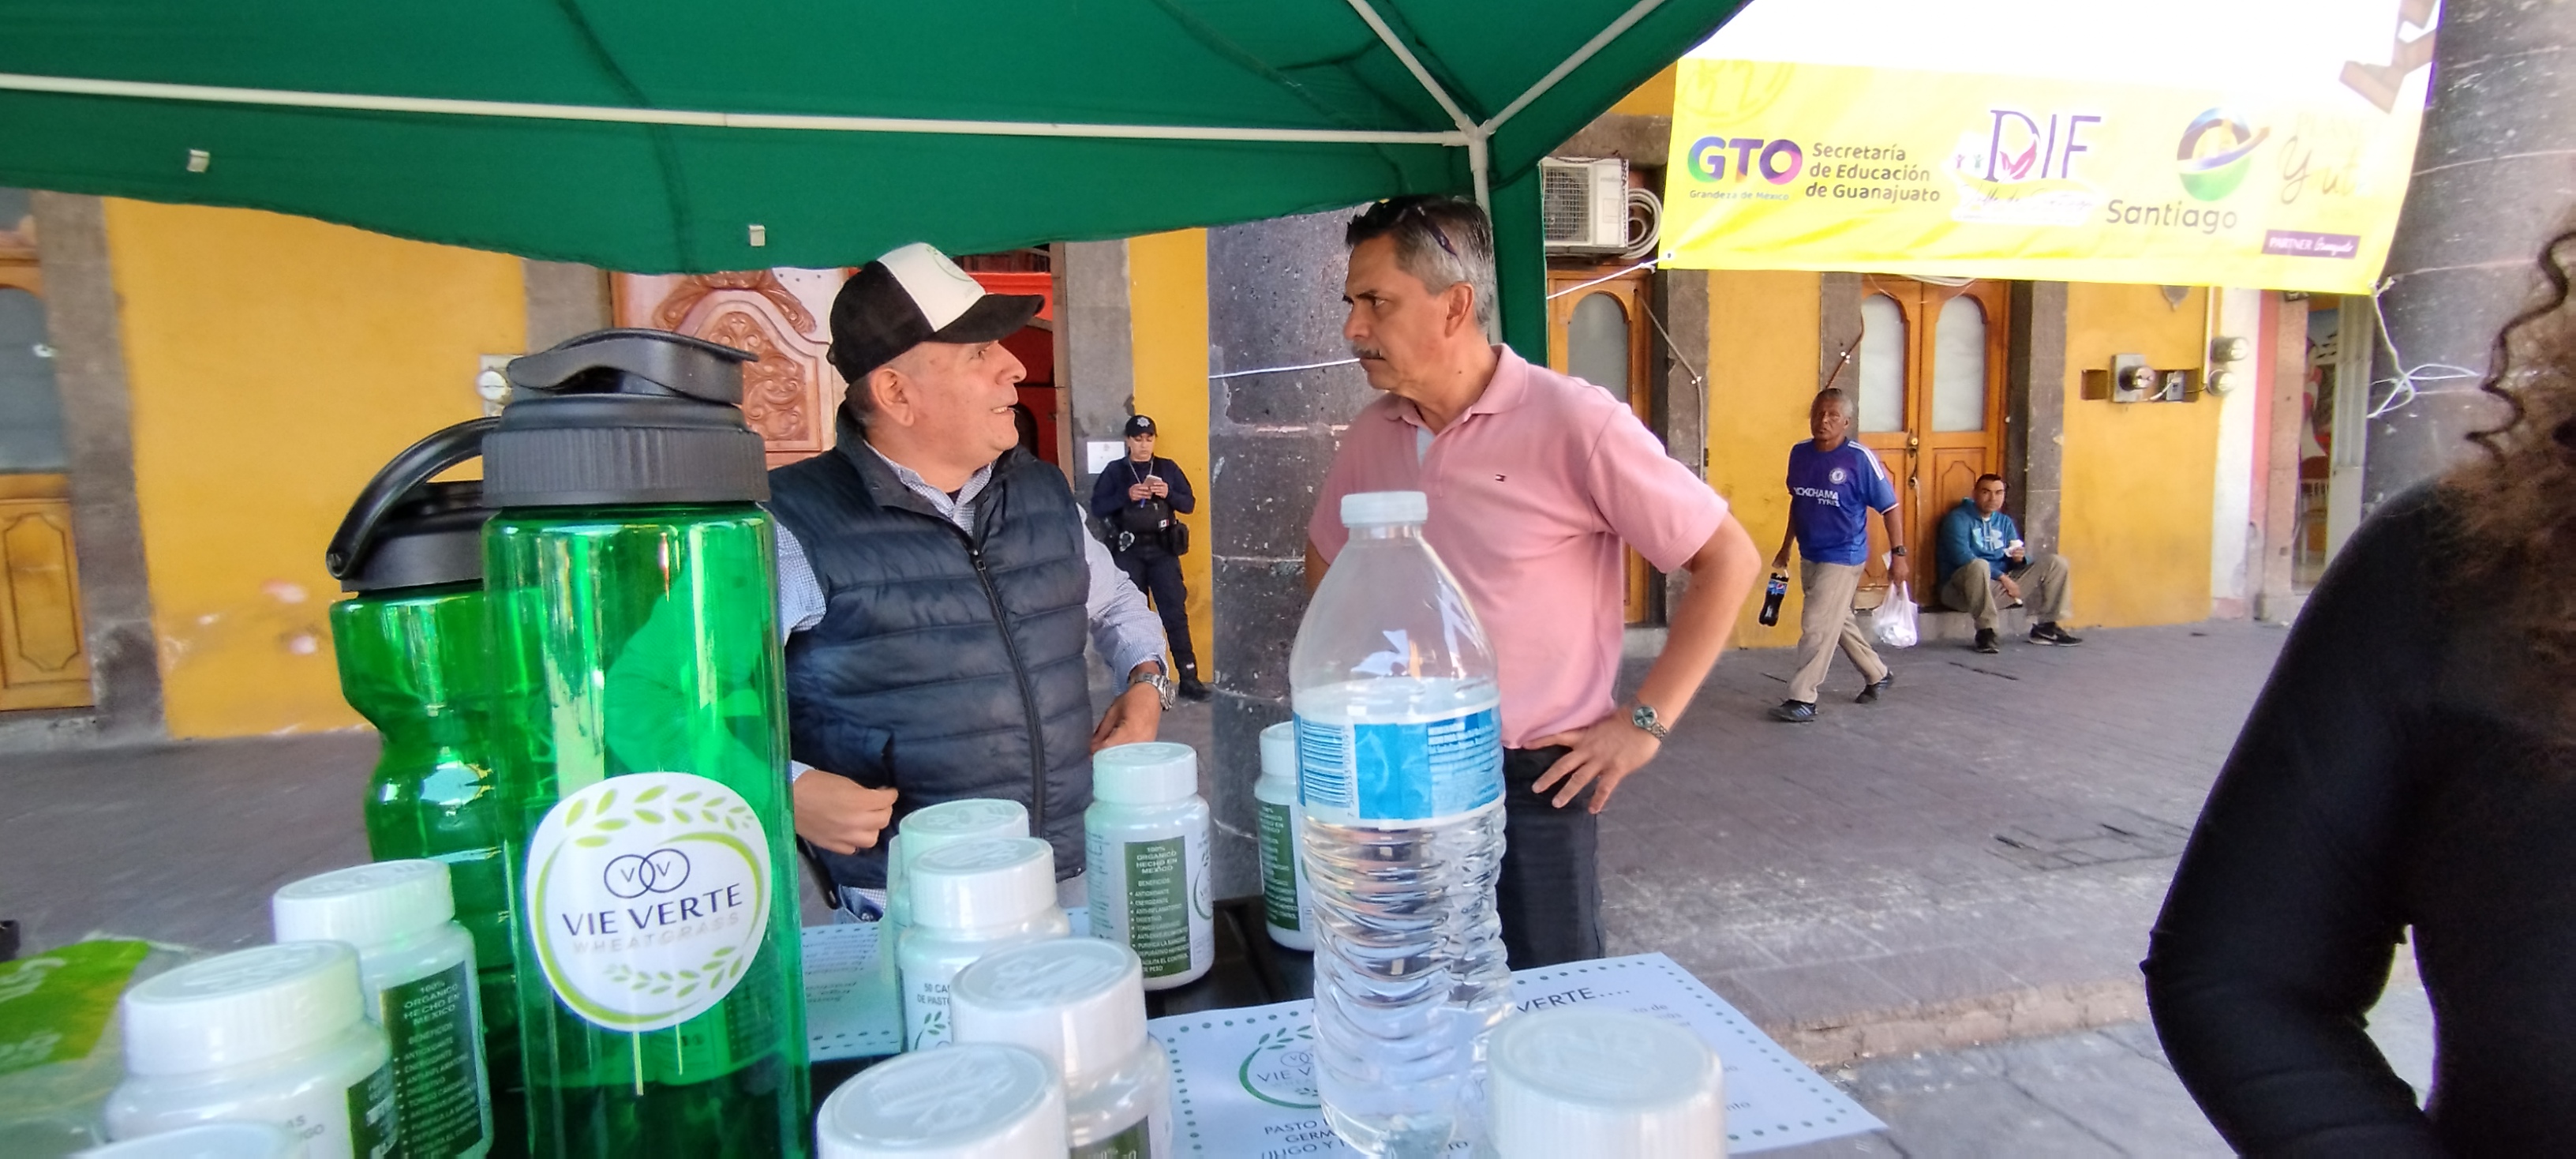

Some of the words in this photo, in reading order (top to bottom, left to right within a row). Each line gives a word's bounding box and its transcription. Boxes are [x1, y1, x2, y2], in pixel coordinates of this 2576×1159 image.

[1812, 141, 1907, 162] Secretaría
[1983, 109, 2102, 182] DIF
[1687, 136, 1803, 186] GTO
[1809, 162, 1831, 178] de
[1836, 163, 1931, 182] Educación
[1689, 189, 1738, 200] Grandeza
[1740, 190, 1754, 200] de
[1755, 190, 1790, 201] México
[1805, 182, 1828, 198] de
[1833, 184, 1941, 204] Guanajuato
[2106, 199, 2237, 235] Santiago
[562, 910, 619, 937] VIE
[627, 883, 743, 930] VERTE
[572, 911, 740, 955] WHEATGRASS
[917, 993, 926, 1003] DE
[1256, 1069, 1293, 1082] VIE
[1264, 1120, 1318, 1135] PASTO
[1285, 1129, 1336, 1143] GERM
